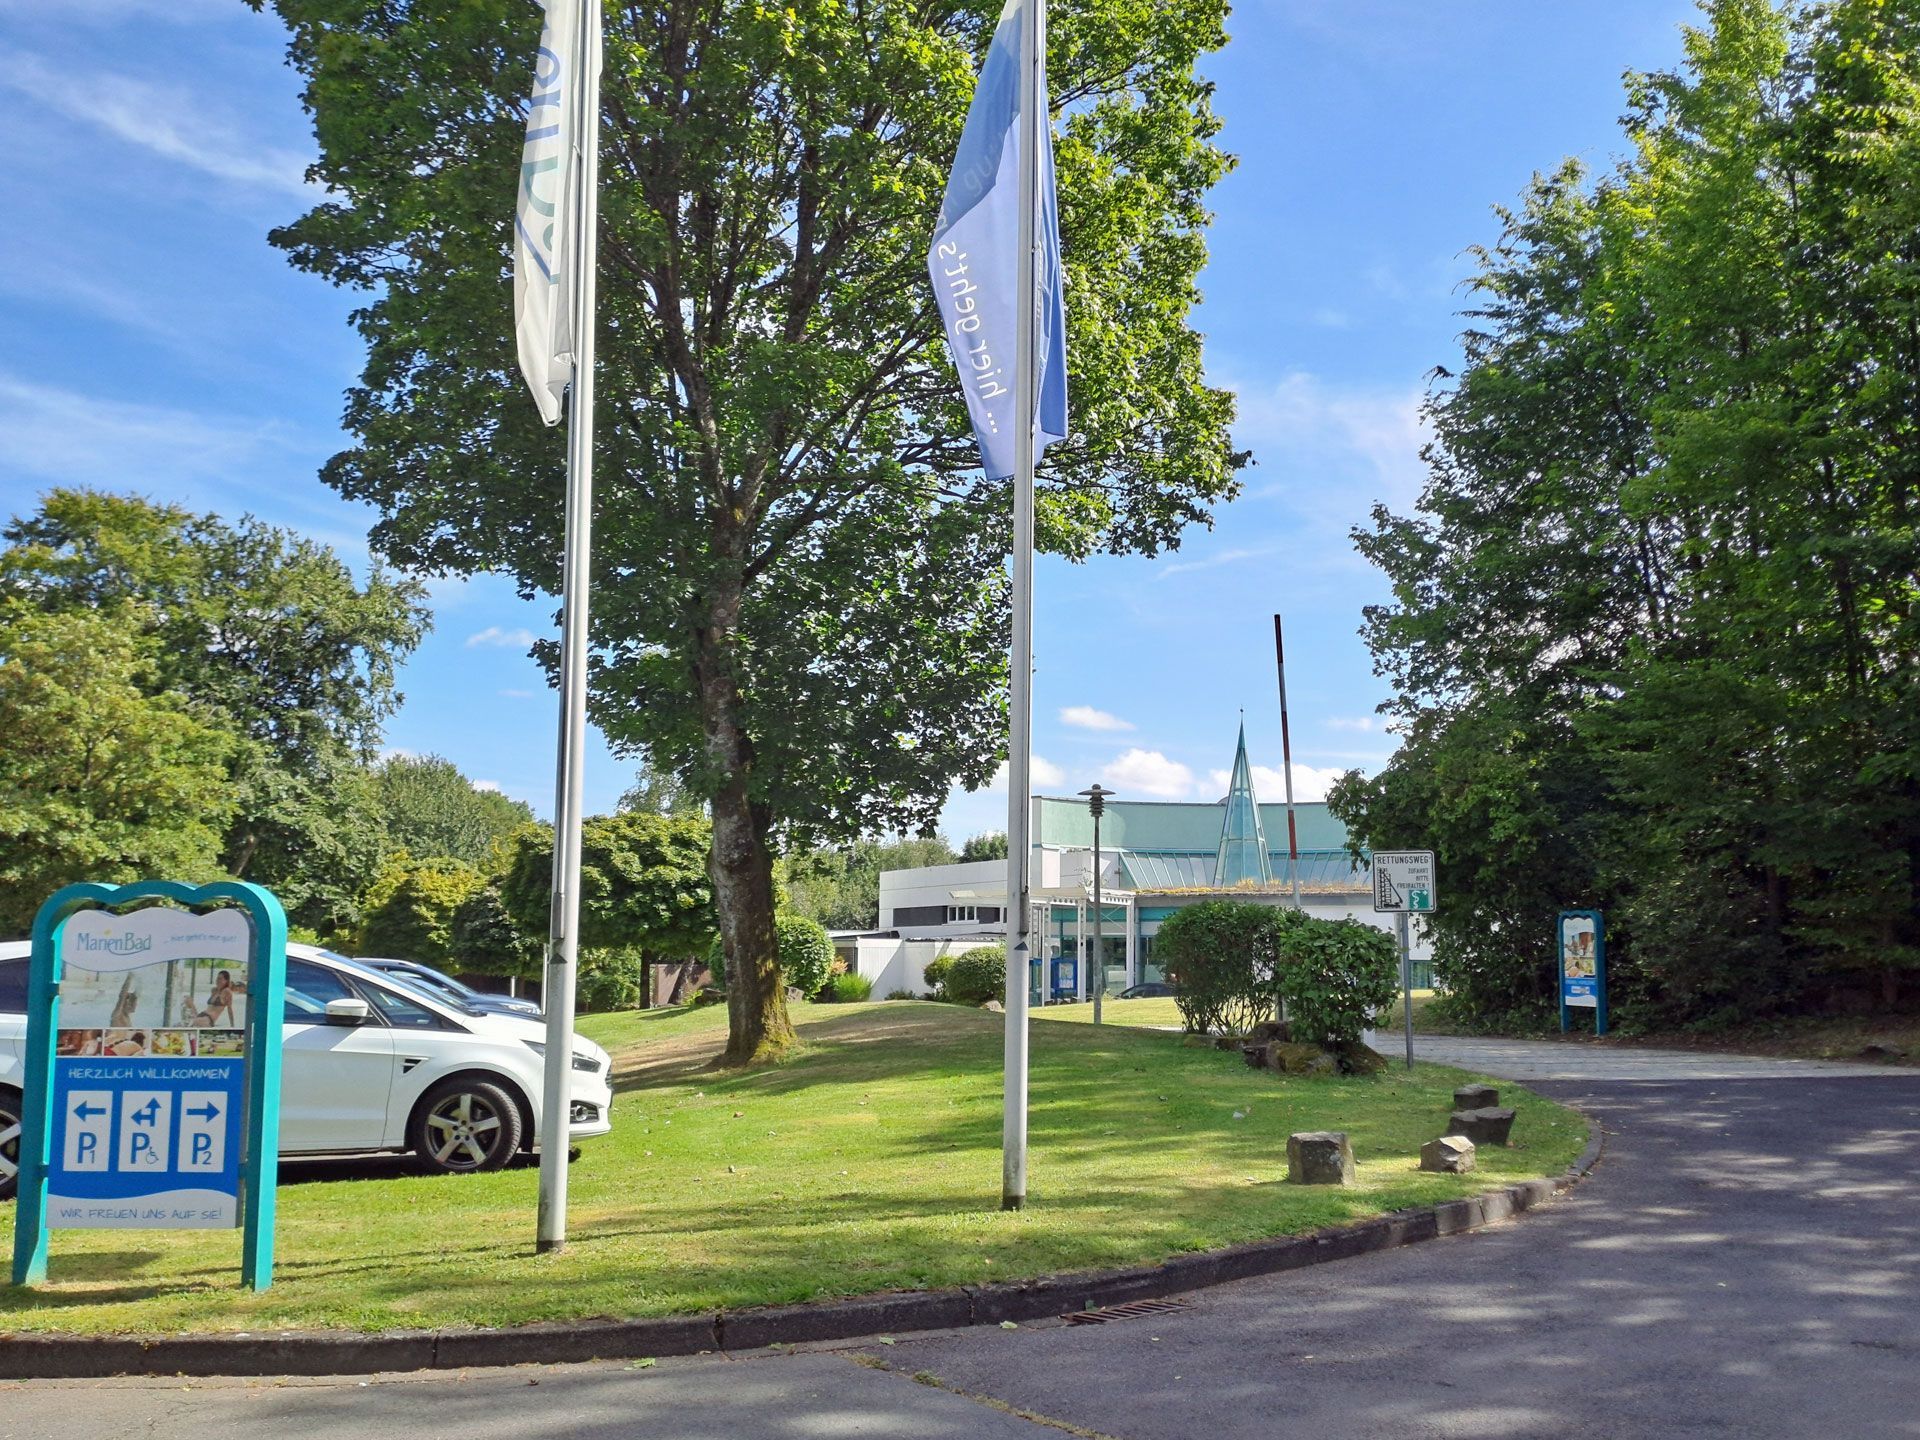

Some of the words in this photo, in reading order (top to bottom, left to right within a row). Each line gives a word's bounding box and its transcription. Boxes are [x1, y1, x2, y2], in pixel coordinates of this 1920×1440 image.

[1377, 856, 1429, 864] RETTUNGSWEG
[68, 1068, 134, 1079] HERZLICH
[138, 1066, 230, 1079] WILLKOMMEN!
[130, 1132, 150, 1164] P
[60, 1208, 82, 1219] WIR
[88, 1208, 138, 1219] FREUEN
[142, 1208, 166, 1219] UNS
[171, 1209, 196, 1219] AUF
[201, 1207, 222, 1220] SIE!
